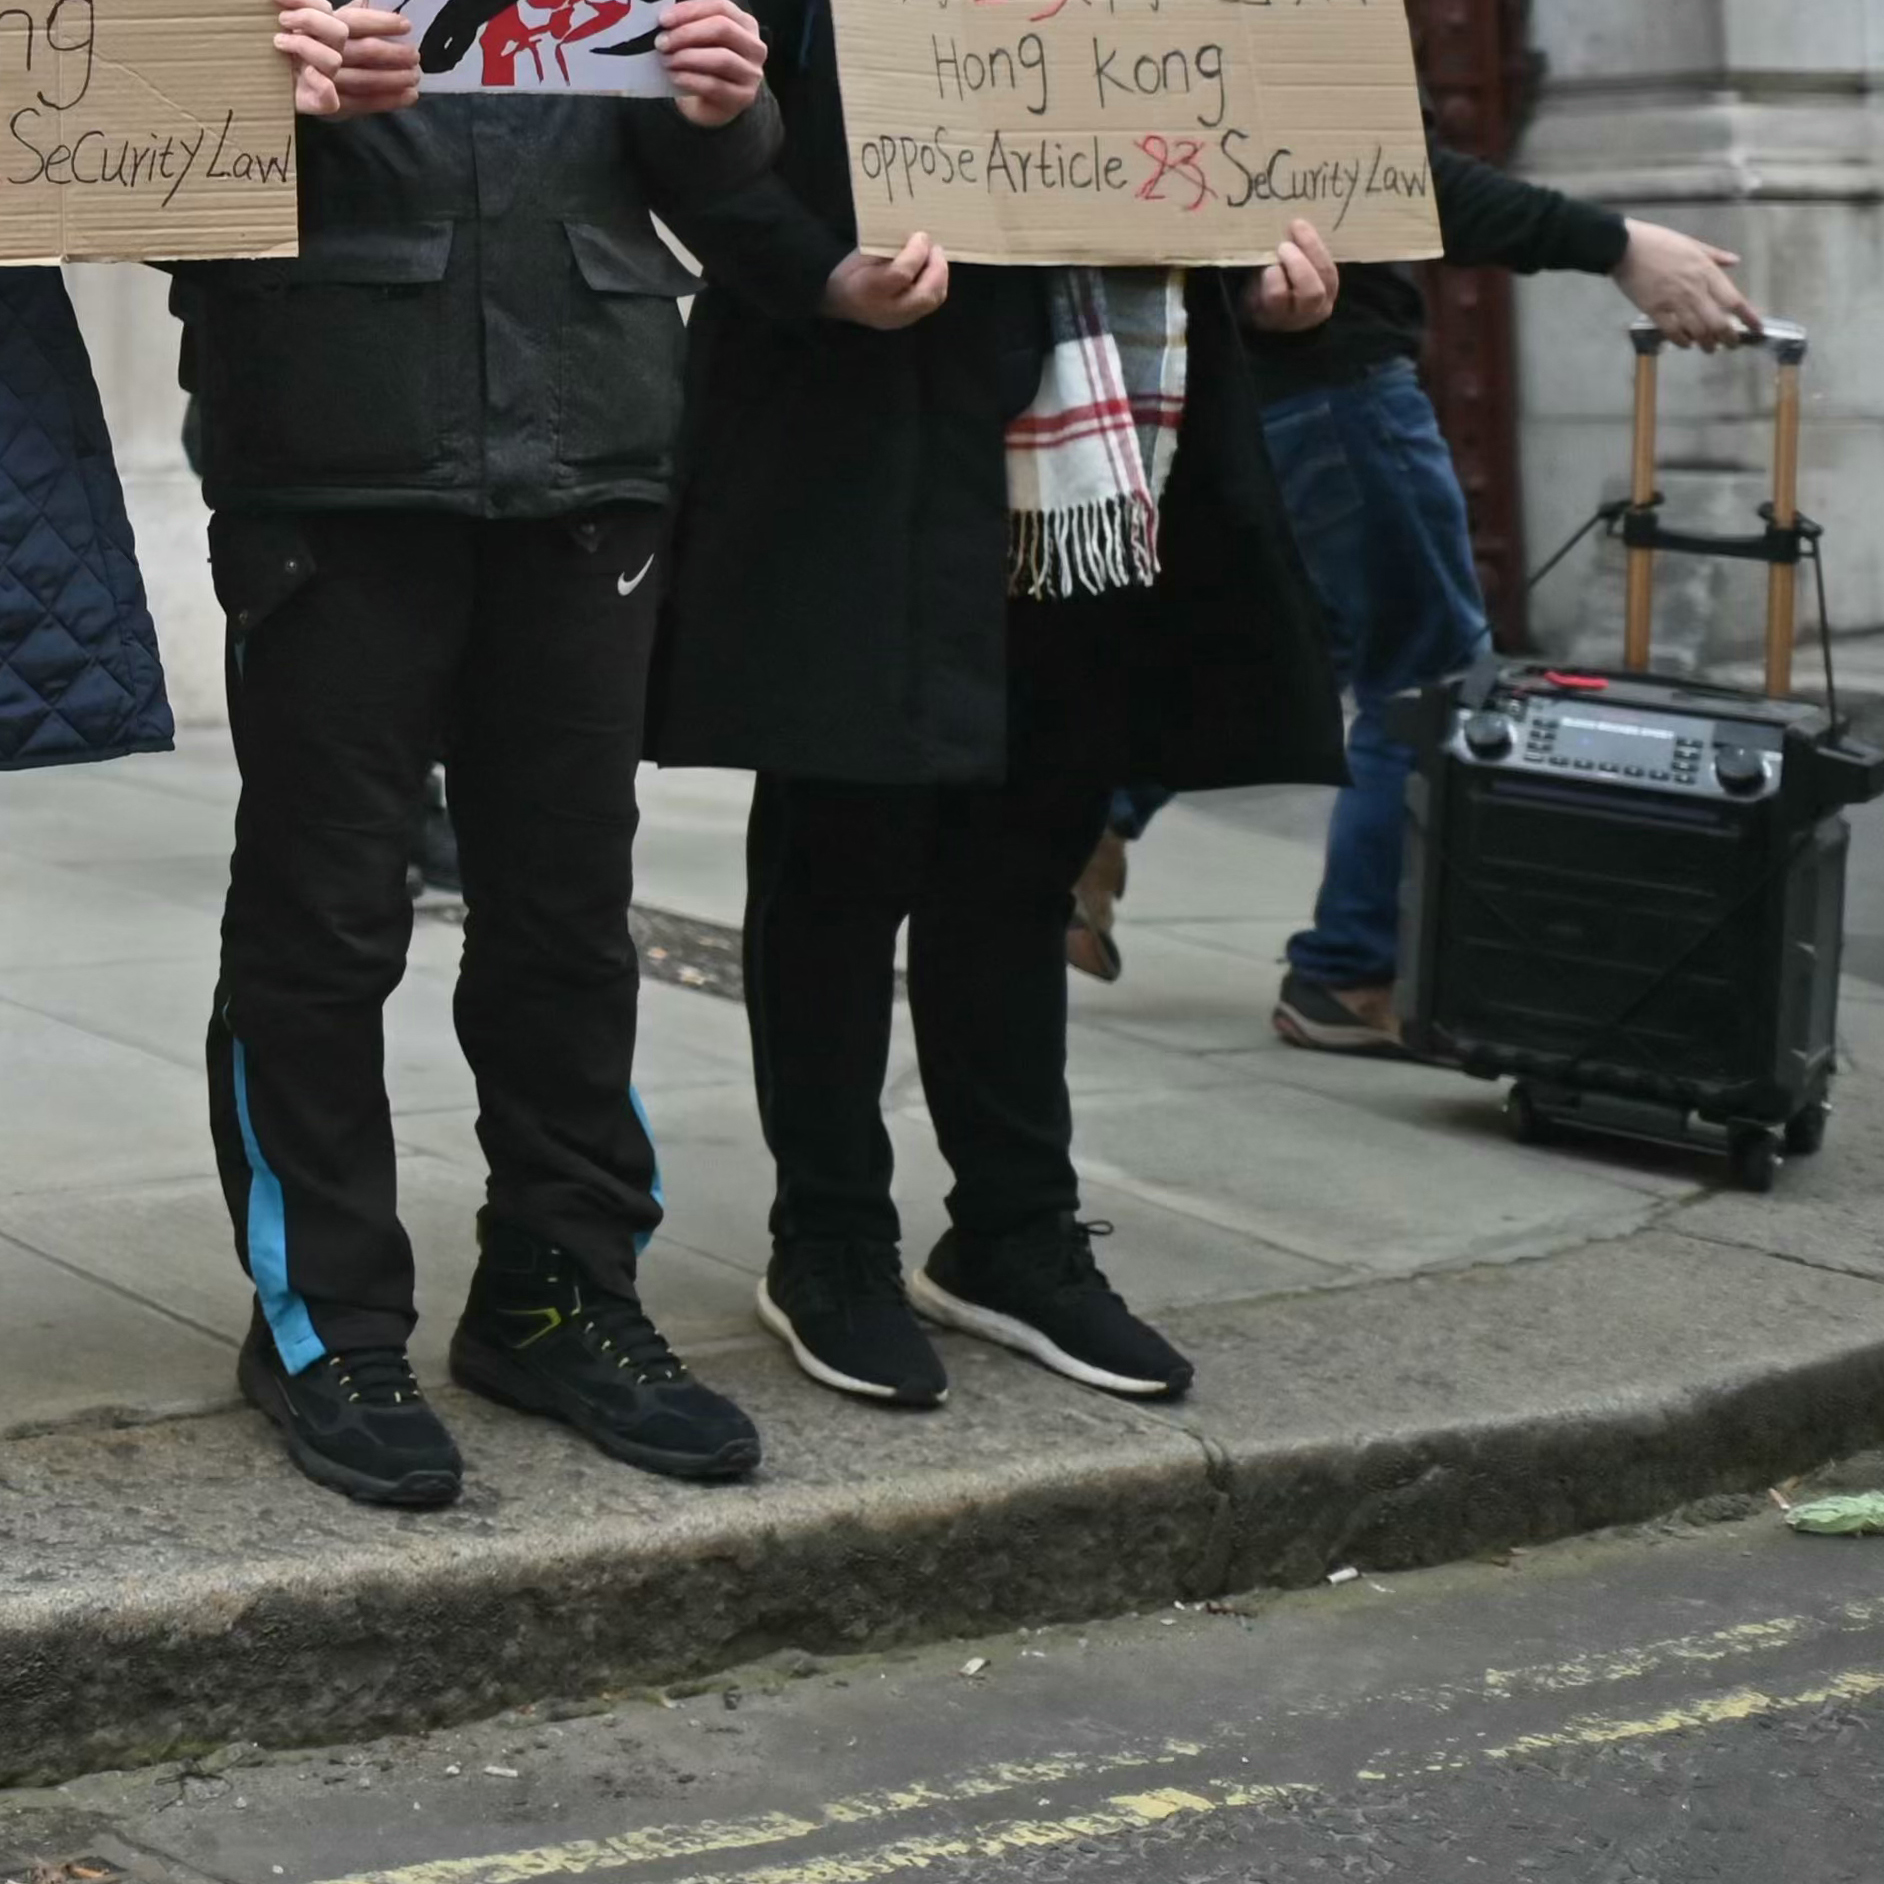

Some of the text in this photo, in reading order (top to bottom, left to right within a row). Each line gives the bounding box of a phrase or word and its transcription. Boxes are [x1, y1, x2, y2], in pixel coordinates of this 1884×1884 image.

[932, 31, 1048, 115] Hong
[209, 109, 292, 183] Law
[986, 129, 1128, 193] Article
[1134, 135, 1217, 210] 23
[1364, 145, 1428, 198] Law
